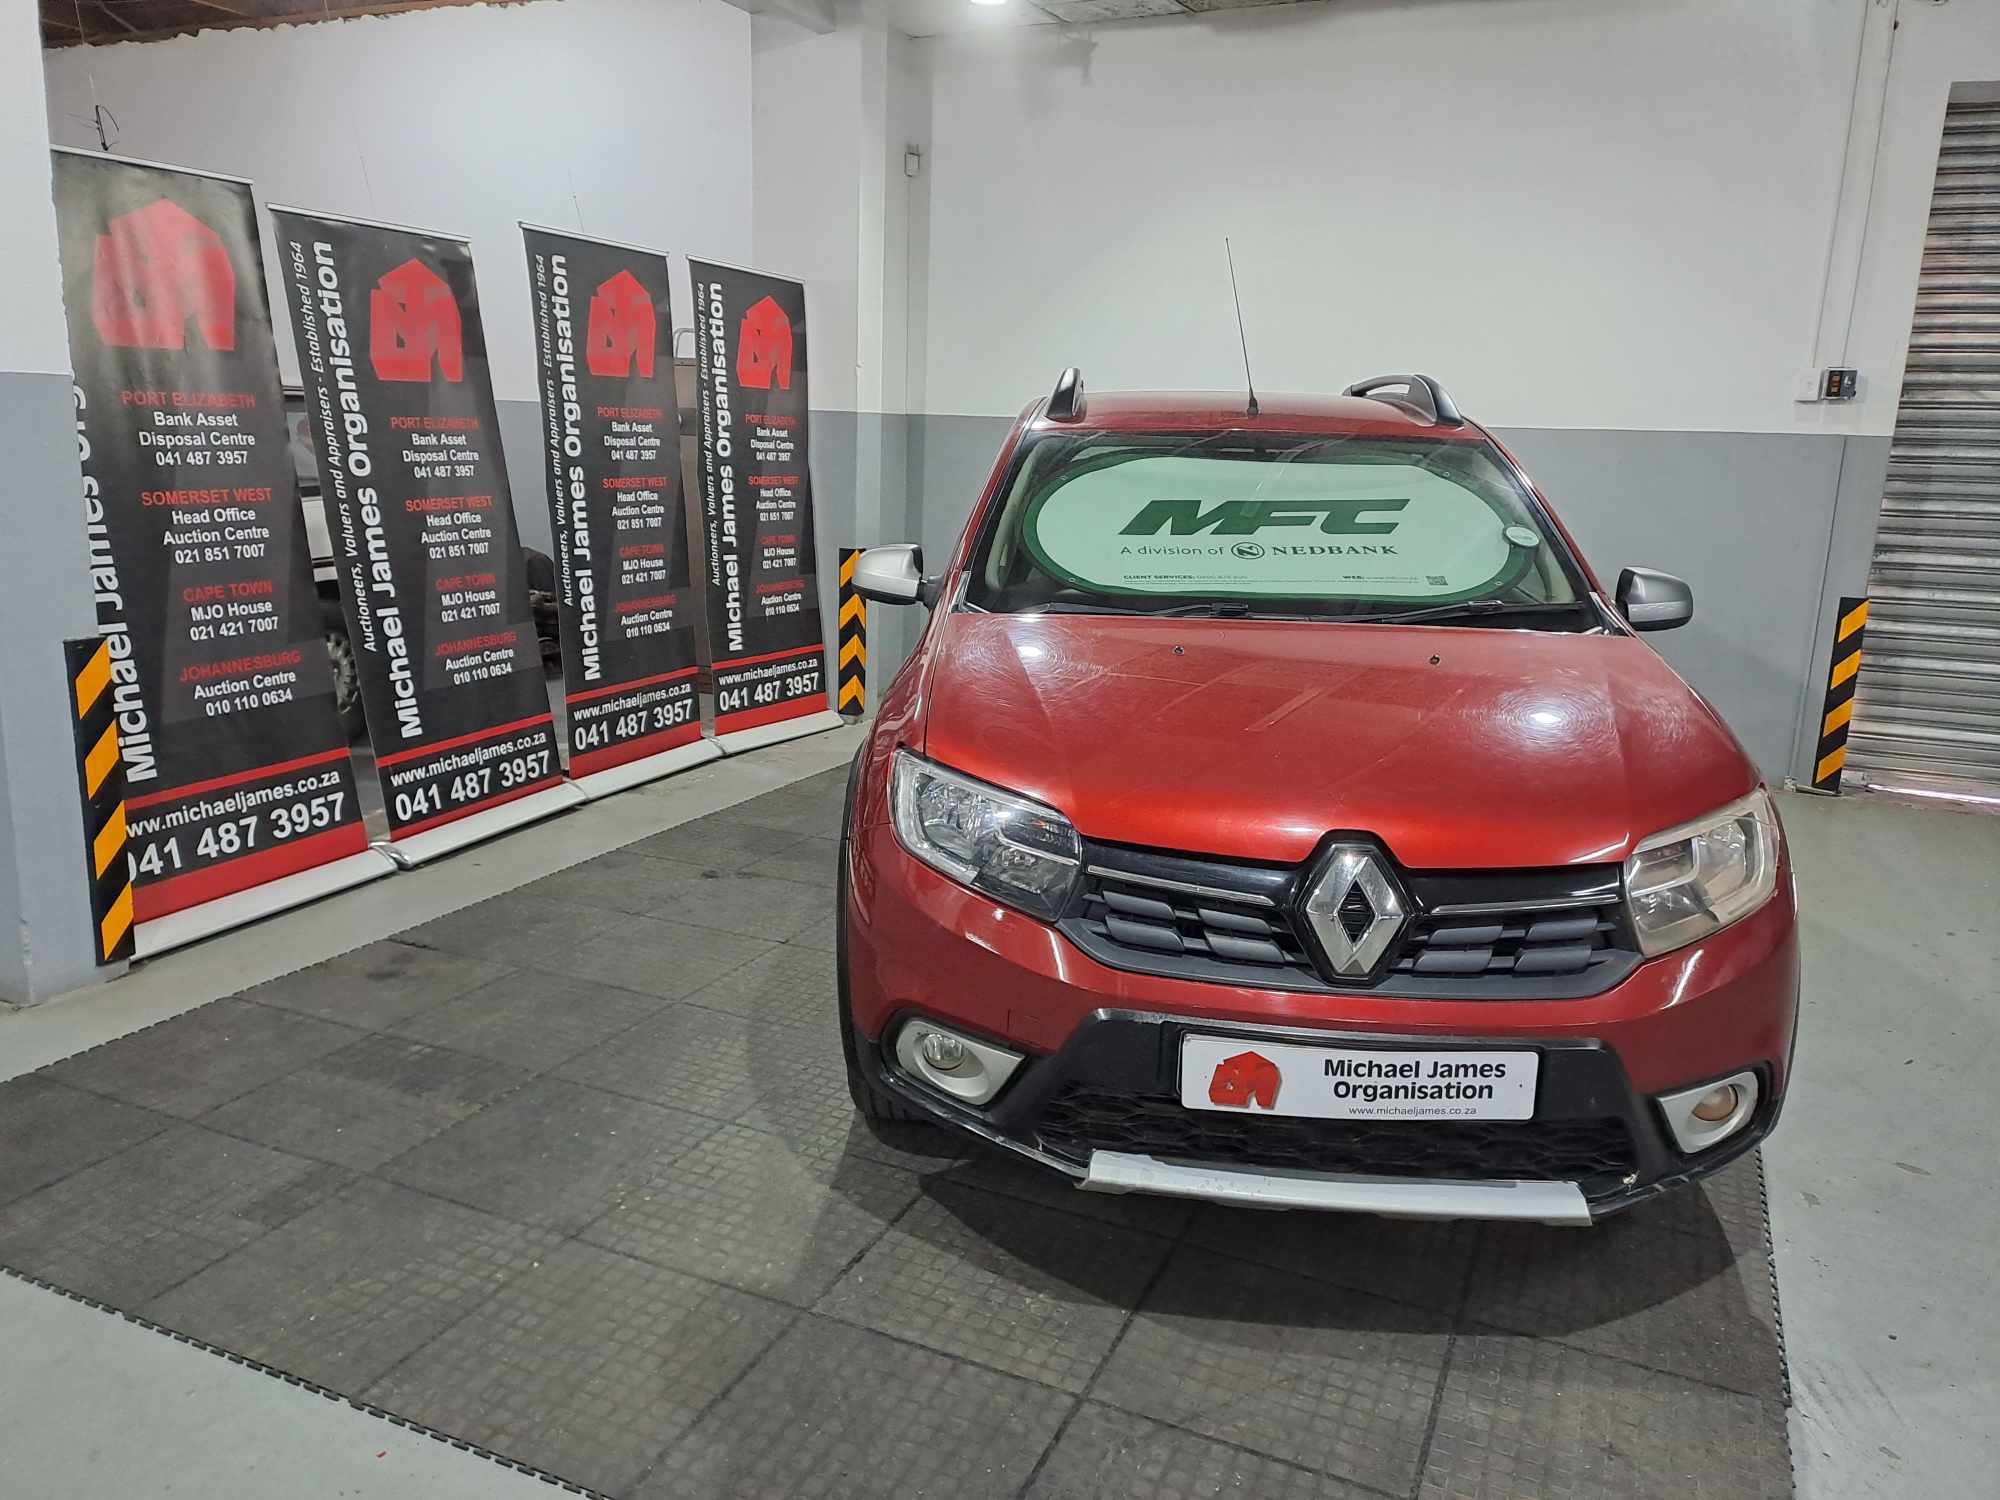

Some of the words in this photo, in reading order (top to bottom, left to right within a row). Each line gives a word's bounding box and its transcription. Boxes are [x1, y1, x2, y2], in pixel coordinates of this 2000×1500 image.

[289, 240, 308, 281] 1964
[535, 254, 547, 288] 1964
[697, 282, 705, 311] 1964
[296, 283, 325, 373] Established
[539, 292, 553, 367] Established
[698, 314, 709, 380] Established
[120, 391, 166, 408] PORT
[154, 411, 193, 426] Bank
[197, 413, 238, 426] Asset
[317, 386, 340, 467] Appraisers
[546, 380, 560, 448] Appraisers
[612, 422, 630, 432] Bank
[632, 422, 653, 432] Asset
[702, 389, 713, 450] Appraisers
[139, 431, 205, 448] Disposal
[210, 432, 255, 446] Centre
[412, 434, 438, 445] Bank
[440, 434, 466, 445] Asset
[604, 436, 636, 448] Disposal
[638, 436, 660, 446] Centre
[156, 452, 182, 465] 041
[187, 452, 210, 465] 487
[217, 451, 248, 464] 3957
[403, 450, 448, 464] Disposal
[450, 449, 479, 461] Centre
[550, 450, 561, 475] and
[704, 451, 712, 473] and
[329, 470, 346, 499] and
[414, 466, 432, 478] 041
[434, 466, 451, 477] 487
[455, 465, 474, 476] 3957
[141, 489, 230, 506] SOMERSET
[233, 488, 272, 501] WEST
[554, 476, 564, 526] Valuers
[612, 506, 639, 516] Auction
[641, 504, 664, 514] Centre
[617, 491, 635, 502] Head
[637, 491, 658, 501] Office
[706, 476, 716, 516] Valuers
[720, 464, 737, 548] James
[172, 509, 210, 525] Head
[214, 508, 256, 522] Office
[426, 514, 451, 526] Head
[454, 512, 481, 524] Office
[569, 465, 591, 561] James
[1118, 499, 1410, 535] MFC
[164, 529, 220, 545] Auction
[225, 526, 269, 541] Centre
[339, 502, 358, 558] Valuers
[357, 487, 396, 598] James
[421, 530, 459, 544] Auction
[462, 528, 491, 539] Centre
[175, 549, 200, 564] 021
[205, 547, 230, 561] 851
[234, 543, 265, 559] 7007
[429, 547, 446, 559] 021
[449, 545, 466, 557] 851
[468, 542, 488, 554] 7007
[711, 520, 721, 586] Auctioneers,
[1121, 546, 1132, 555] A
[1137, 545, 1203, 556] division
[1207, 545, 1225, 556] of
[1271, 545, 1399, 555] NEDBANK
[557, 529, 574, 607] Auctioneers,
[621, 574, 634, 584] 021
[183, 586, 224, 602] CAPE
[228, 580, 272, 596] TOWN
[442, 593, 462, 606] MJO
[465, 590, 496, 602] House
[723, 554, 743, 652] Michael
[191, 605, 223, 621] MJO
[228, 601, 272, 617] House
[351, 562, 376, 652] Auctioneers,
[441, 611, 459, 622] 021
[461, 607, 477, 619] 421
[479, 603, 500, 616] 7007
[621, 613, 648, 625] Auction
[650, 609, 672, 620] Centre
[190, 626, 215, 641] 021
[219, 622, 244, 636] 421
[248, 617, 278, 633] 7007
[575, 568, 601, 681] Michael
[626, 627, 638, 638] 010
[641, 625, 652, 635] 110
[180, 650, 301, 682] JOHANNESBURG
[376, 607, 423, 740] Michael
[446, 654, 481, 670] Auction
[484, 649, 514, 662] Centre
[719, 658, 818, 686] www.michaeljames.co.za
[194, 679, 249, 700] Auction
[253, 671, 296, 688] Centre
[453, 672, 470, 685] 010
[472, 667, 488, 680] 110
[490, 663, 512, 676] 0634
[99, 623, 158, 783] Michael
[206, 701, 231, 716] 010
[234, 695, 259, 710] 110
[262, 688, 293, 706] 0634
[574, 683, 691, 721] www.michaeljames.co.za
[720, 687, 748, 711] 041
[754, 681, 780, 704] 487
[786, 672, 819, 696] 3957
[575, 720, 608, 751] 041
[616, 710, 648, 738] 487
[653, 698, 693, 728] 3957
[391, 732, 546, 787] www.michaeljames.co.za
[395, 783, 442, 821] 041
[451, 768, 491, 802] 487
[499, 750, 549, 787] 3957
[127, 770, 339, 838] ww.michaeljames.co.za
[197, 816, 258, 858] 487
[270, 791, 344, 839] 3957
[1323, 1058, 1421, 1079] Michael
[1427, 1061, 1507, 1080] James
[1333, 1081, 1494, 1102] Organisation
[1348, 1105, 1477, 1117] www.michaeljames.co.za
